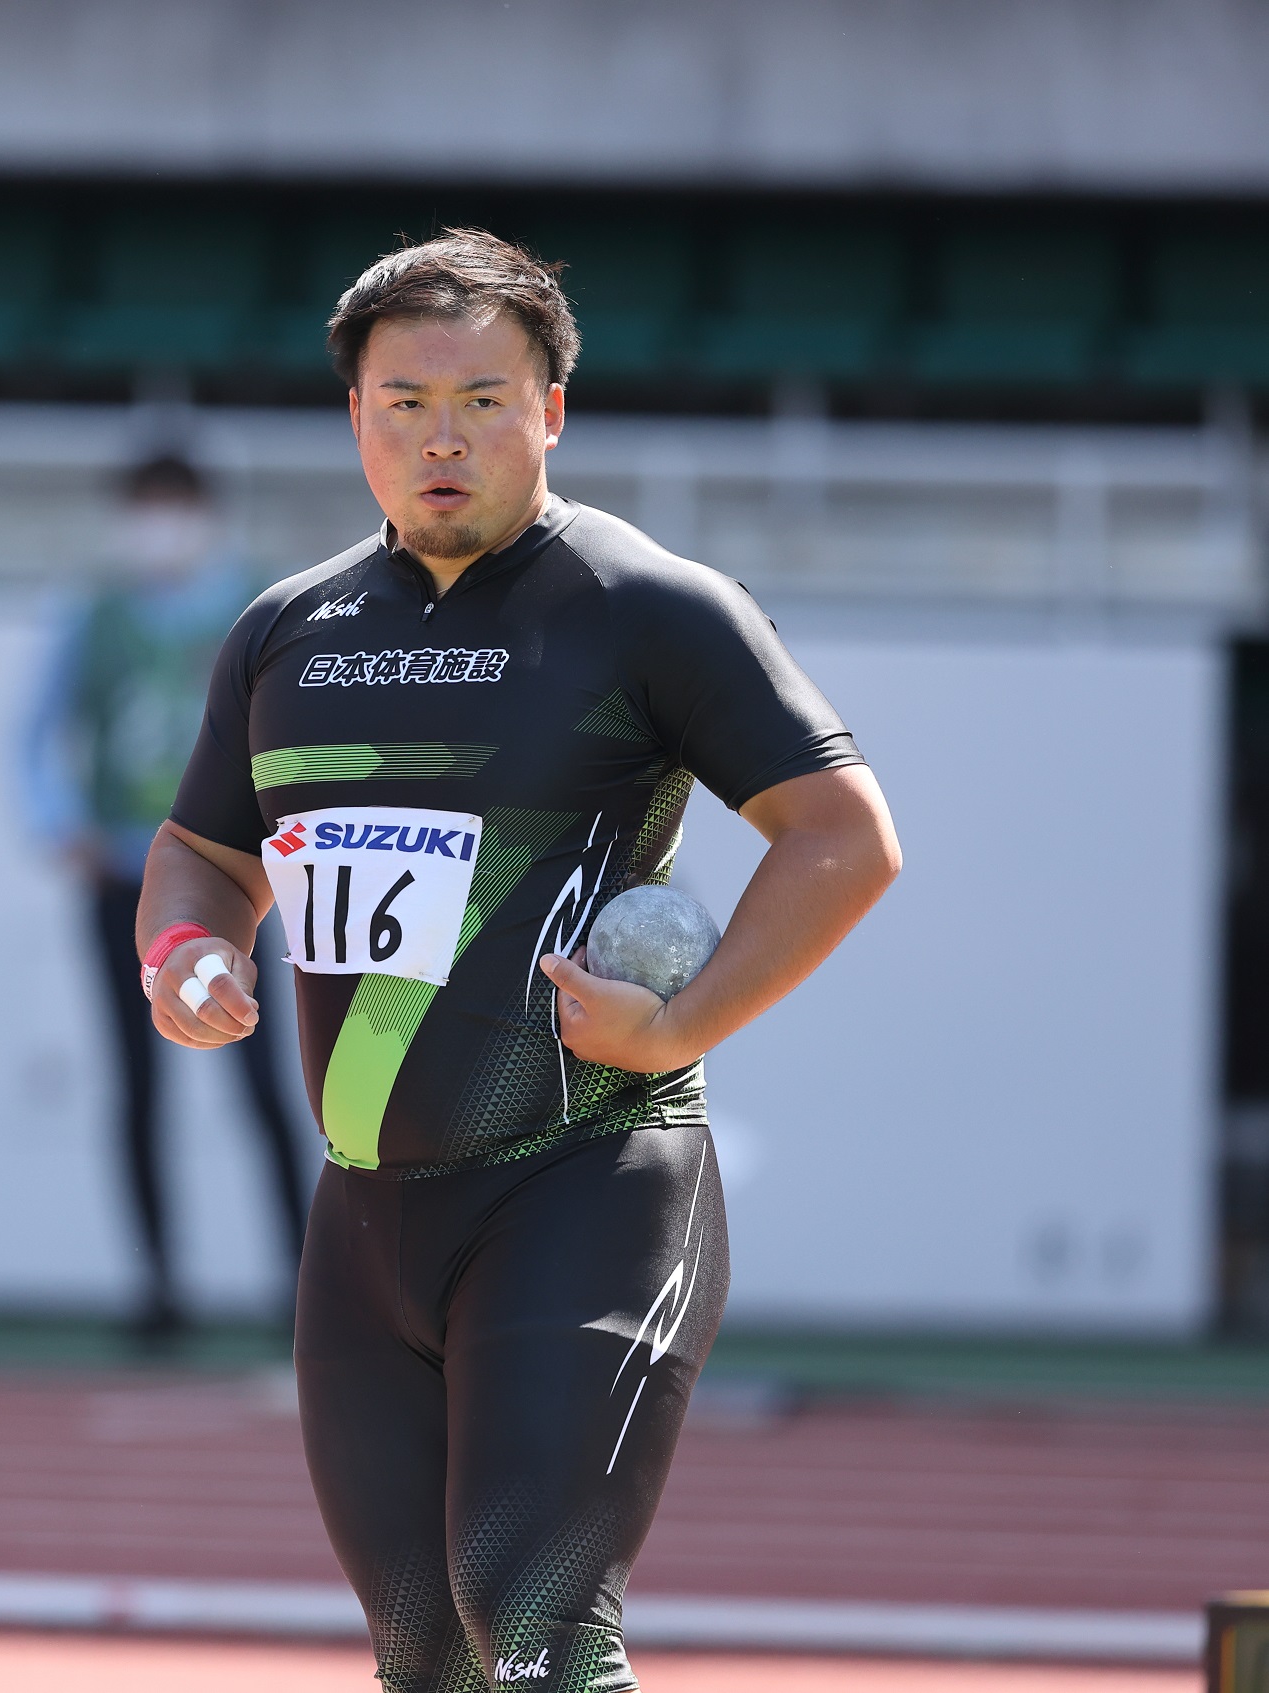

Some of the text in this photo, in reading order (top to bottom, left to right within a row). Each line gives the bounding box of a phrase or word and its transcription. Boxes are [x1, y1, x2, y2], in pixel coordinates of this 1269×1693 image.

[299, 648, 509, 687] 日本体育施設
[315, 822, 475, 862] SUZUKI
[303, 864, 416, 963] 116
